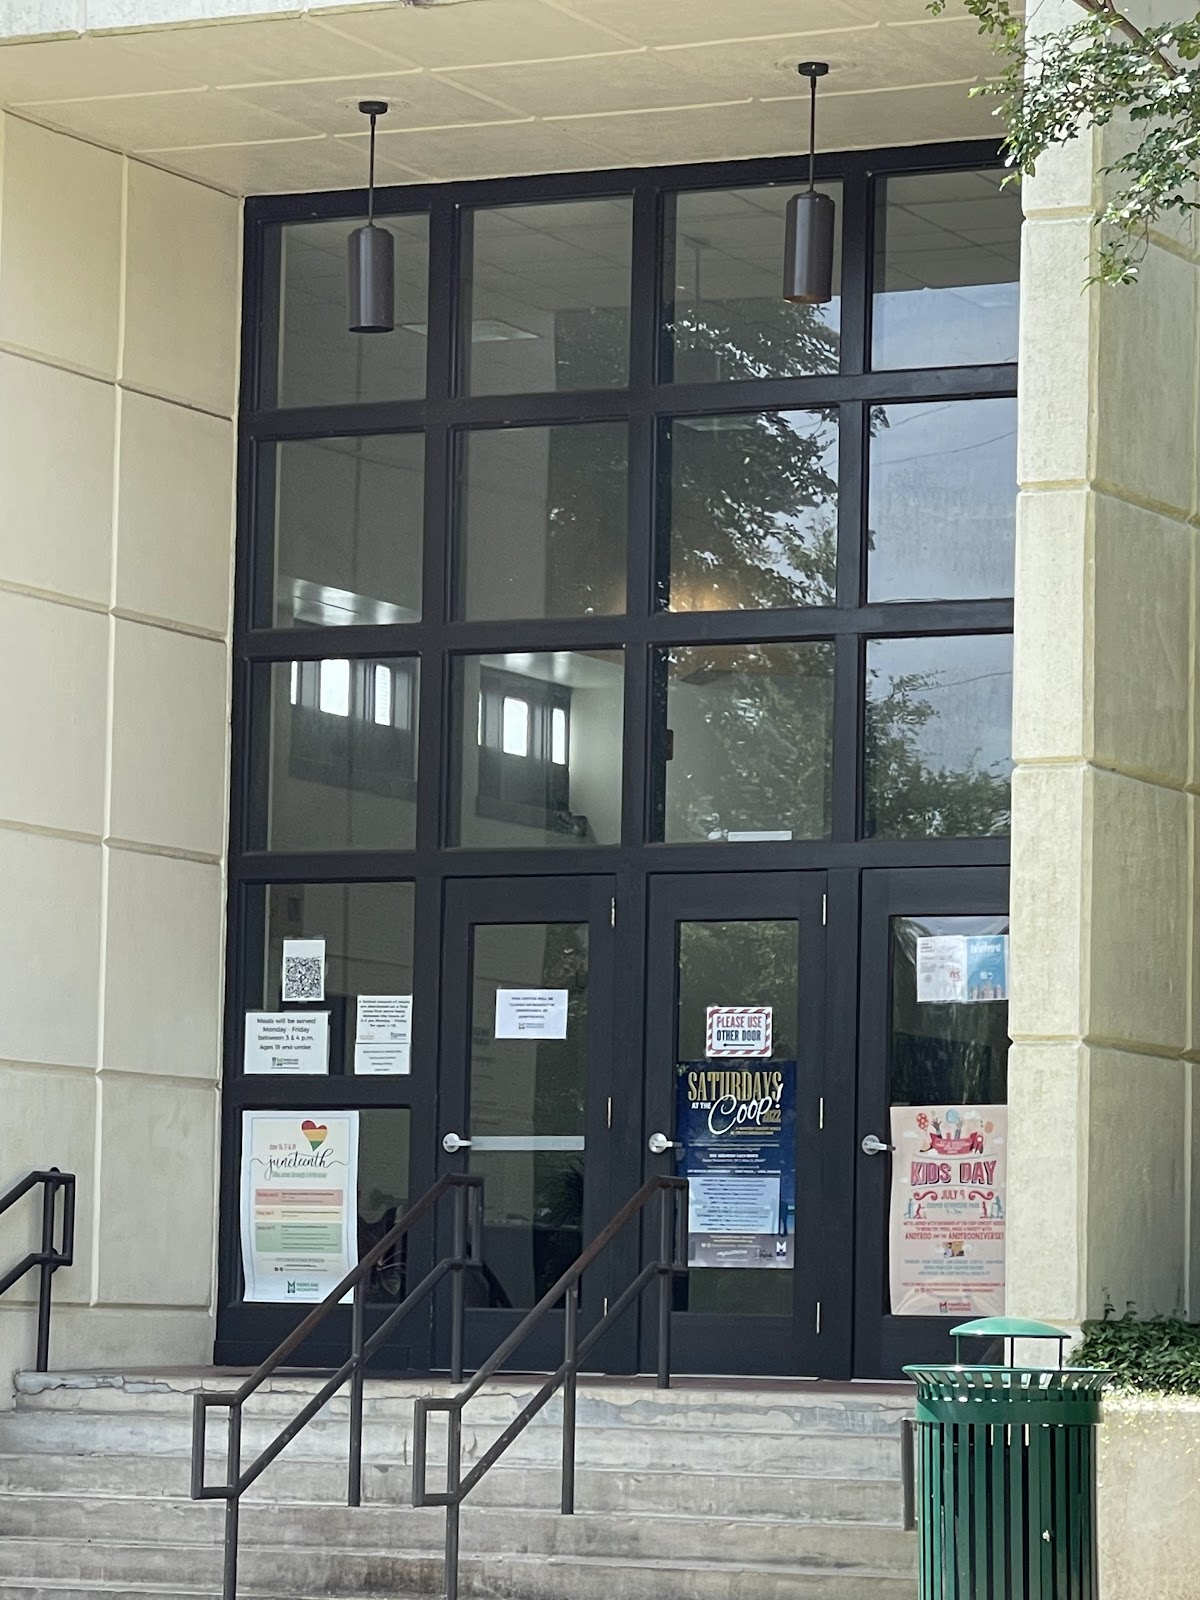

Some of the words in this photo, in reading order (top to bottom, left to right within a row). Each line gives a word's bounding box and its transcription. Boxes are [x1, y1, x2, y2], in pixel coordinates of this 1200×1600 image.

[717, 1016, 744, 1028] PLEASE
[748, 1016, 762, 1028] USE
[717, 1030, 739, 1041] OTHER
[742, 1030, 761, 1041] DOOR
[688, 1072, 782, 1101] SATURDAYS
[262, 1148, 335, 1180] juneteenth
[911, 1161, 951, 1186] KIDS
[960, 1160, 996, 1185] DAY
[941, 1190, 957, 1200] JULY
[960, 1190, 965, 1200] 9
